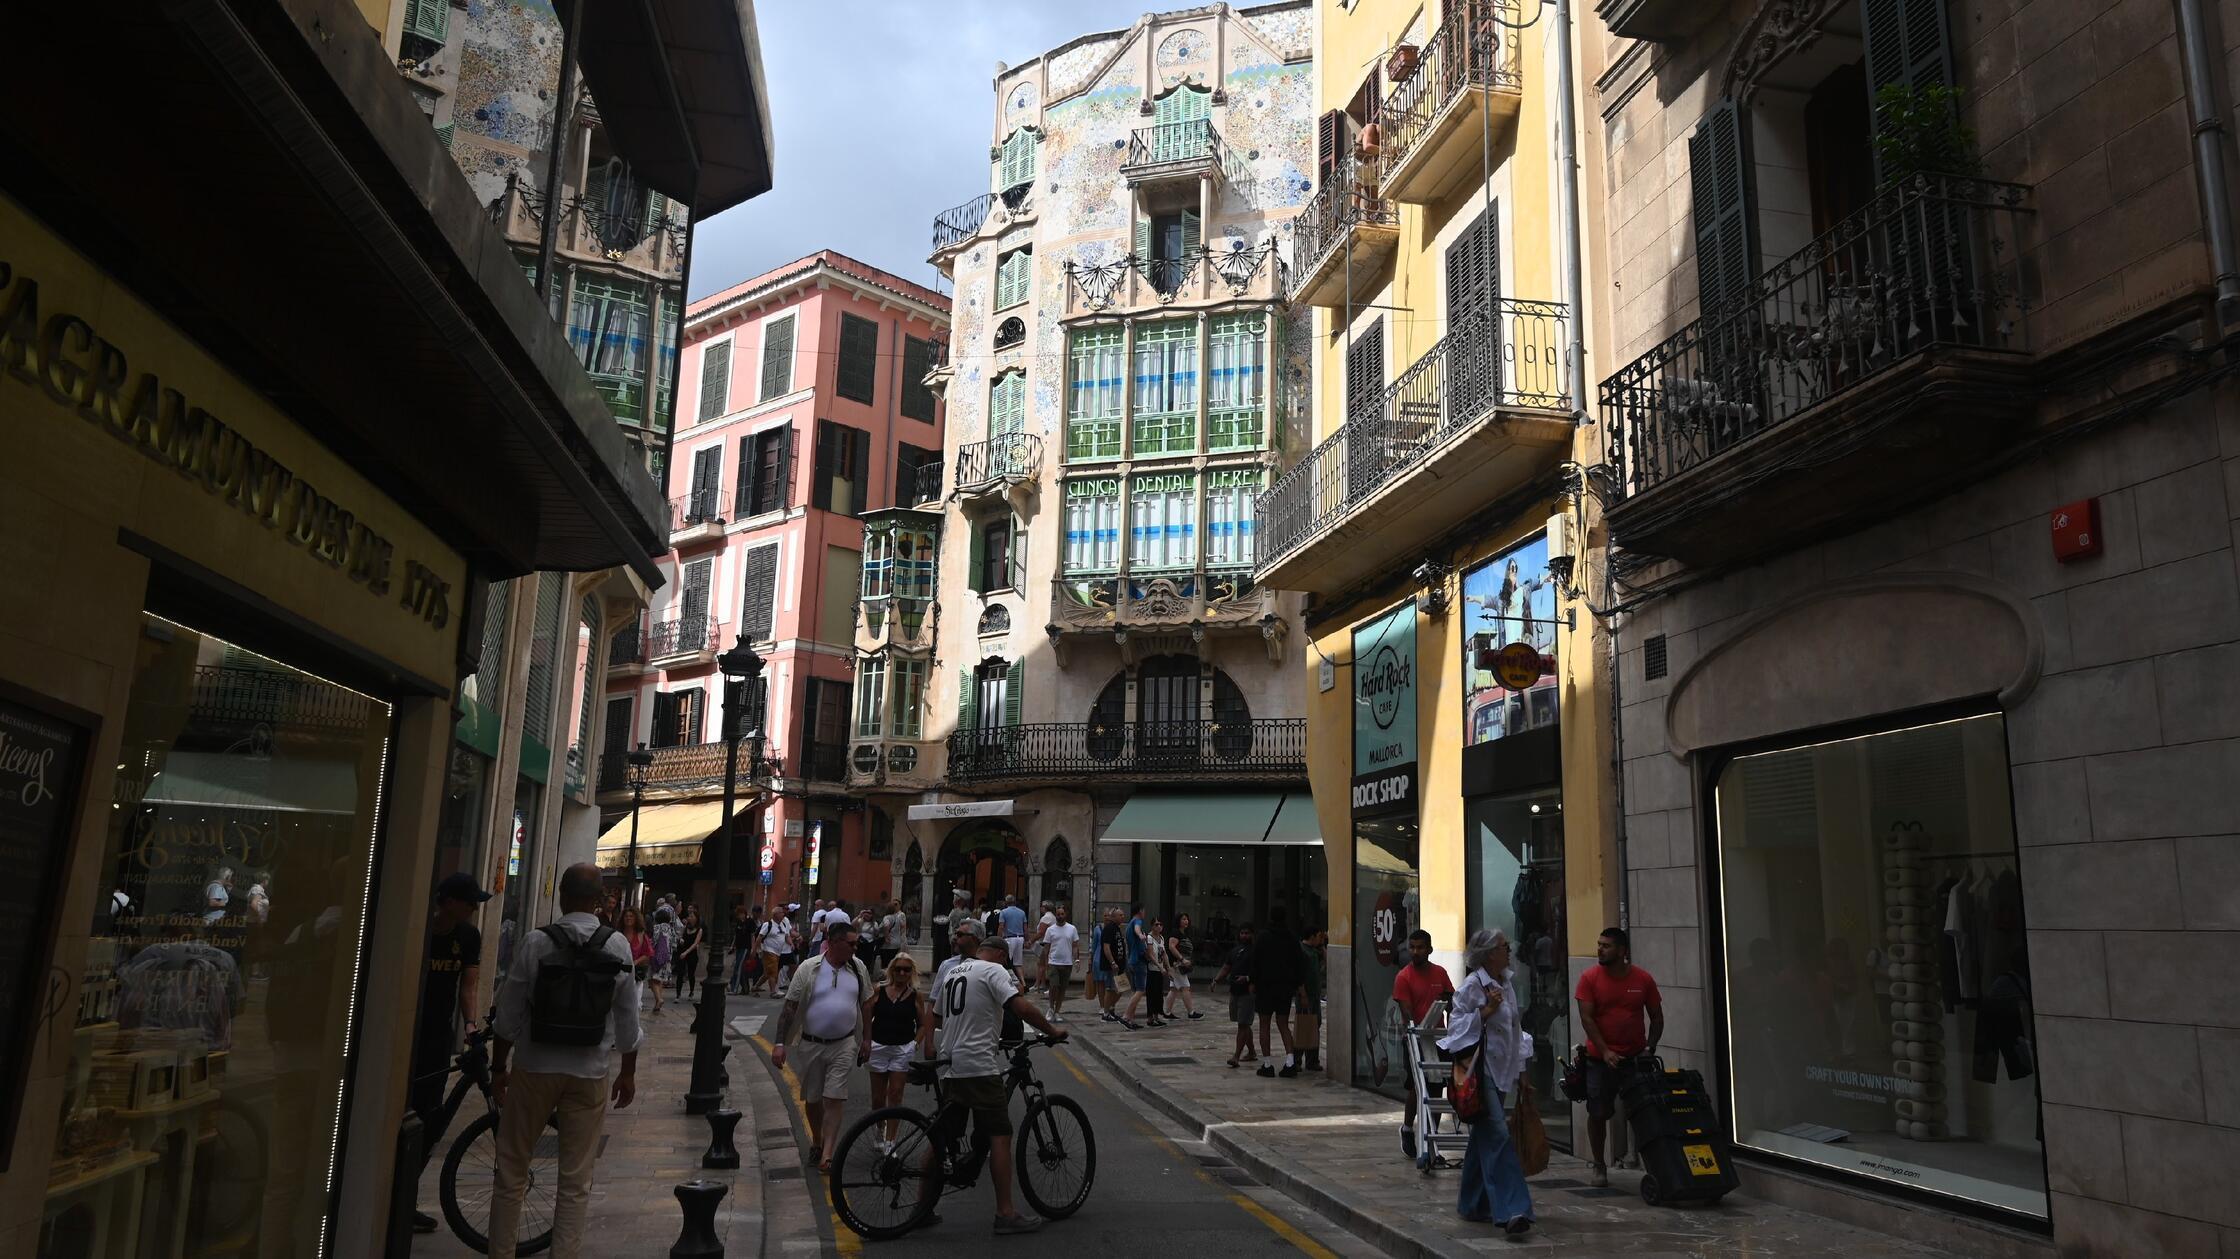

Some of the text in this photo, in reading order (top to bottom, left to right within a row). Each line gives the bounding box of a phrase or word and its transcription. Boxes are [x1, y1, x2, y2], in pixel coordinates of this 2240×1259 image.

[1068, 479, 1119, 497] CLINICA
[1134, 474, 1193, 493] DENTAL
[399, 559, 452, 631] 1775
[1361, 663, 1386, 699] Hard
[1386, 654, 1411, 695] Rock
[1378, 700, 1392, 715] CAFE
[1369, 742, 1403, 766] MALLORCA
[1353, 774, 1409, 809] ROCK SHOP
[945, 976, 968, 1018] 10
[1806, 1065, 1833, 1082] CRAFT
[1832, 1069, 1859, 1086] YOUR
[1859, 1073, 1882, 1089] OWN
[1859, 1160, 1921, 1179] www.mango.com
